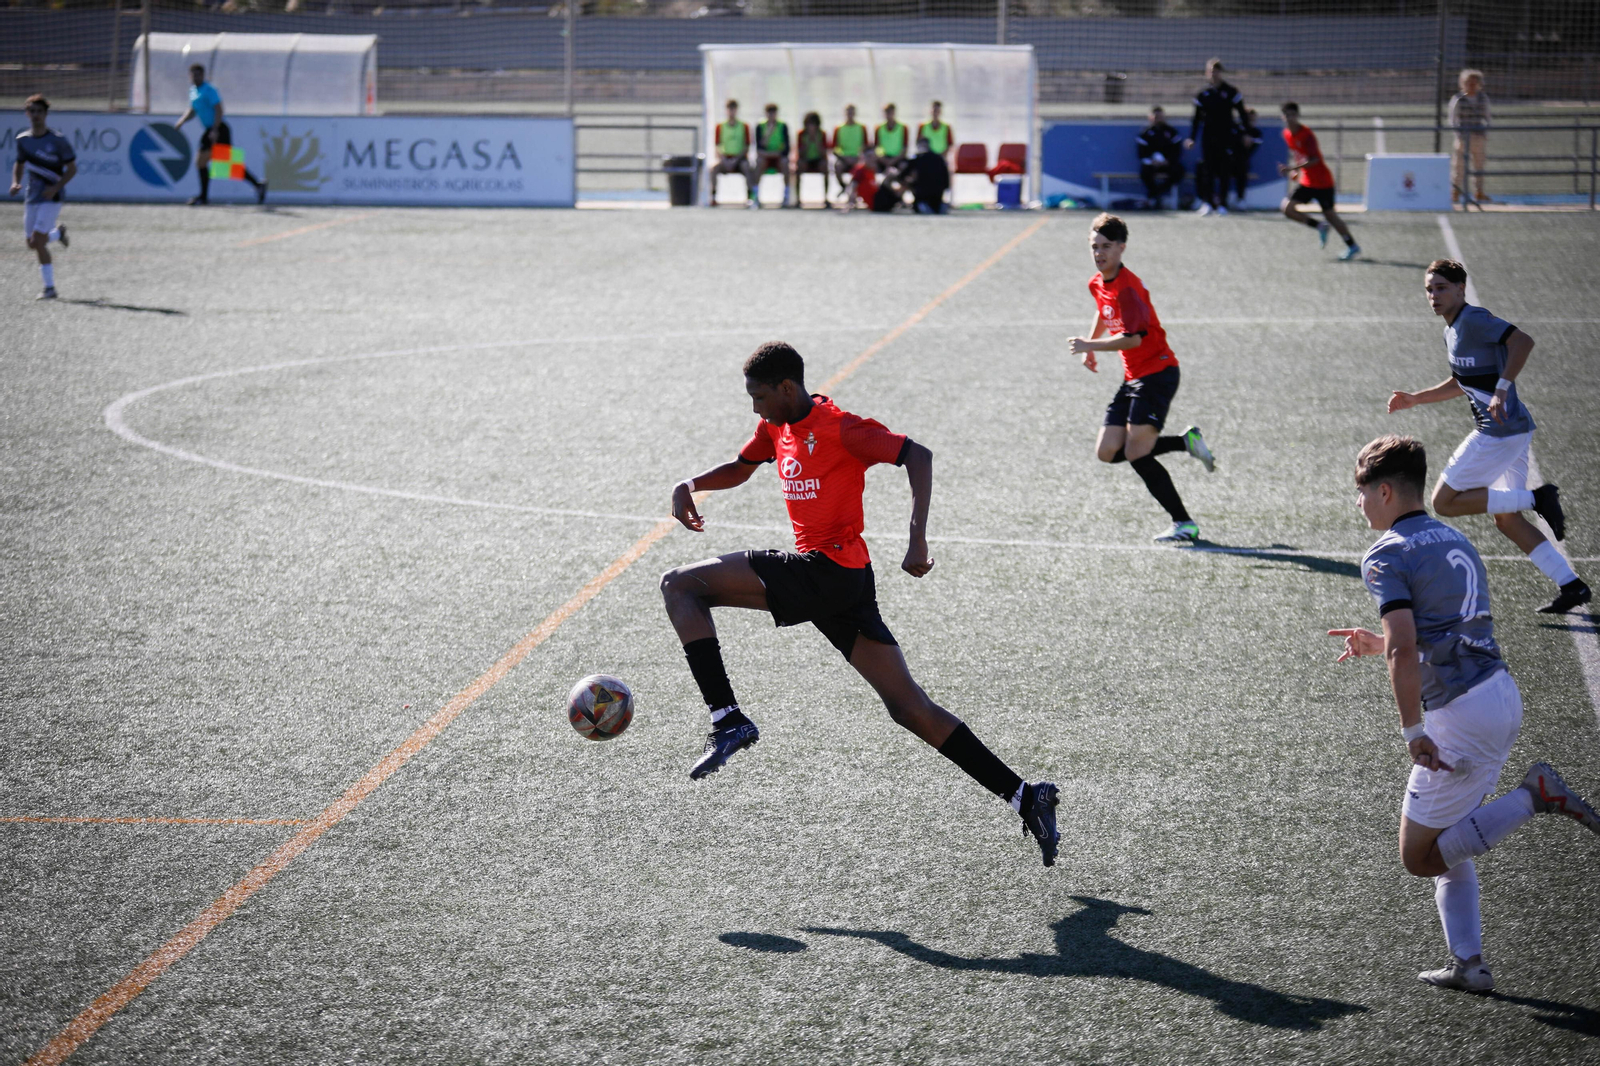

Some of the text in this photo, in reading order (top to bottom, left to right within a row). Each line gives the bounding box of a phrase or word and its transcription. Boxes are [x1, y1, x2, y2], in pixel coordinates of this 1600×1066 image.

[342, 137, 523, 171] MEGASA
[342, 177, 439, 191] SUMINISTROS
[1449, 355, 1476, 367] EUTA
[782, 478, 821, 492] UNDAI
